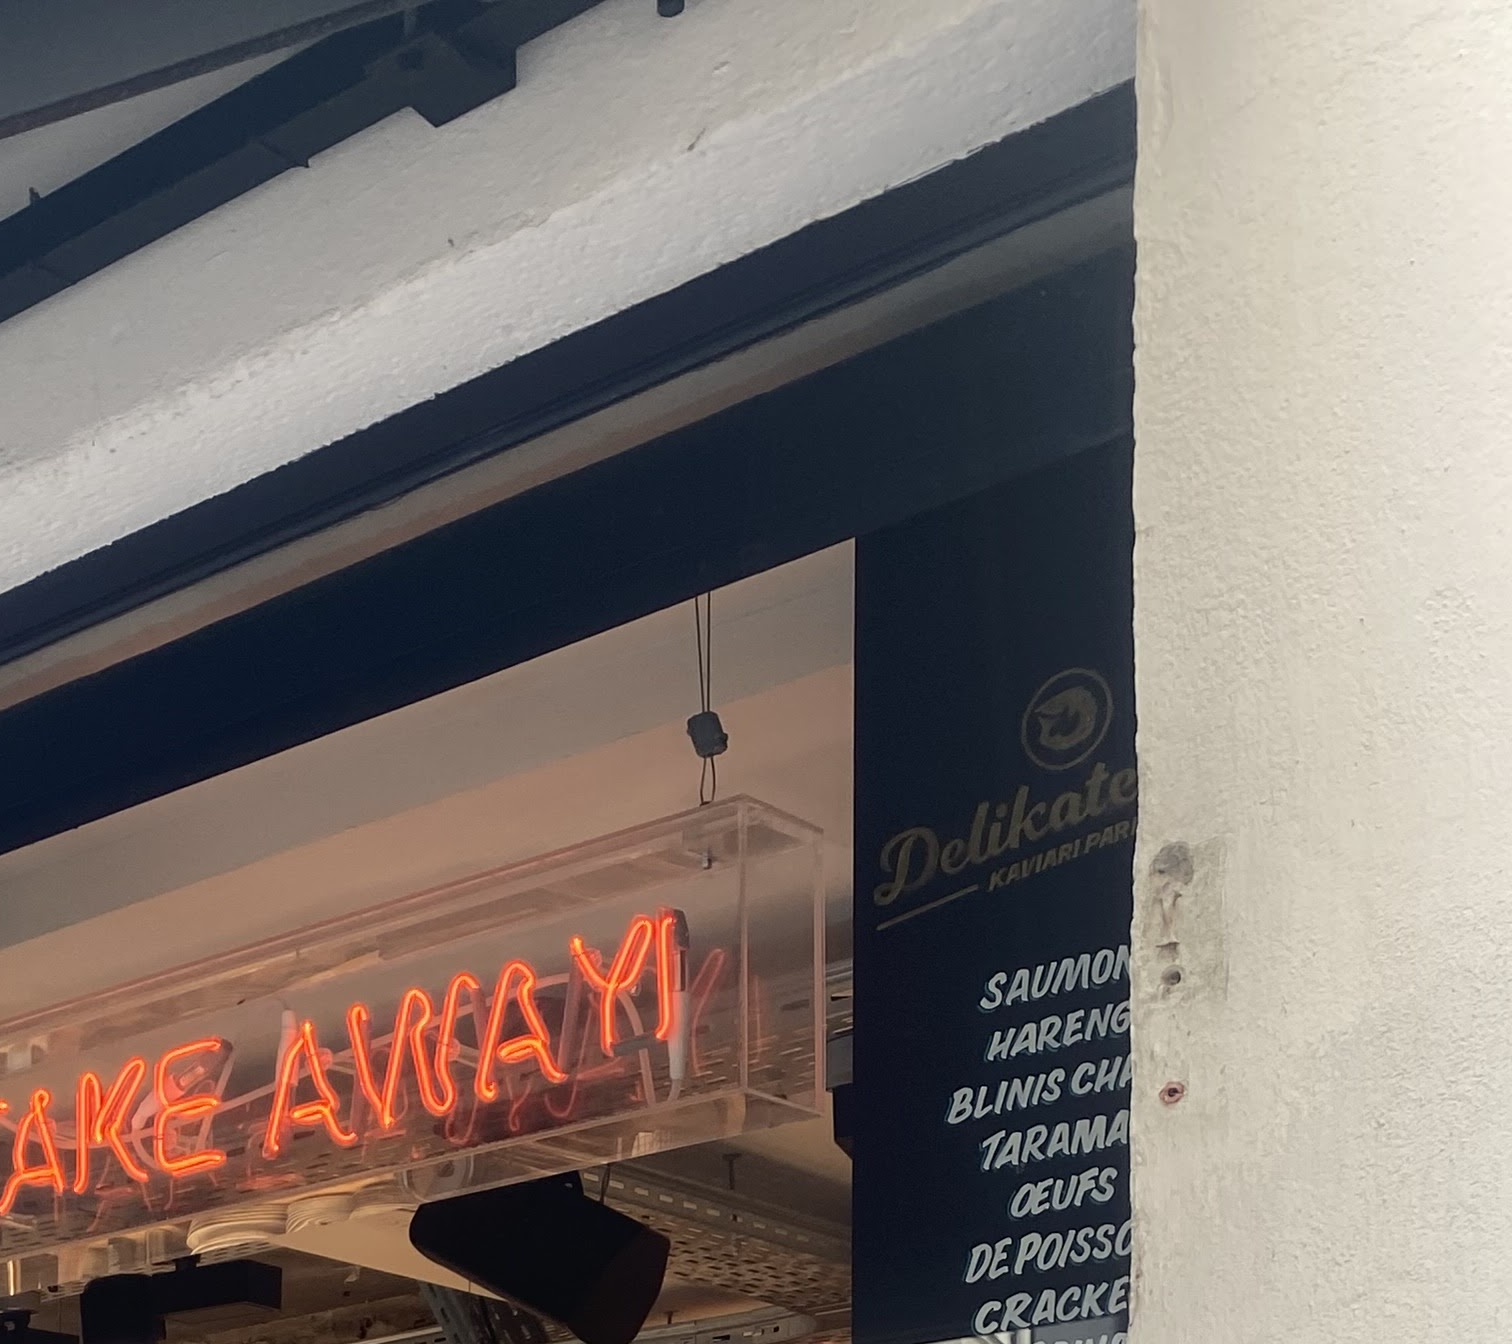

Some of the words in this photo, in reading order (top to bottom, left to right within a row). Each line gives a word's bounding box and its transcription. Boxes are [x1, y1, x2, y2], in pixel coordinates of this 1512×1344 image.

[988, 839, 1081, 892] KAVIARI
[986, 1001, 1131, 1062] HARENG
[946, 1067, 1067, 1125] BLINIS
[980, 1109, 1130, 1172] TARAMA
[1009, 1167, 1119, 1219] ŒUFS
[964, 1236, 1012, 1284] DE
[972, 1276, 1130, 1336] CRACKE
